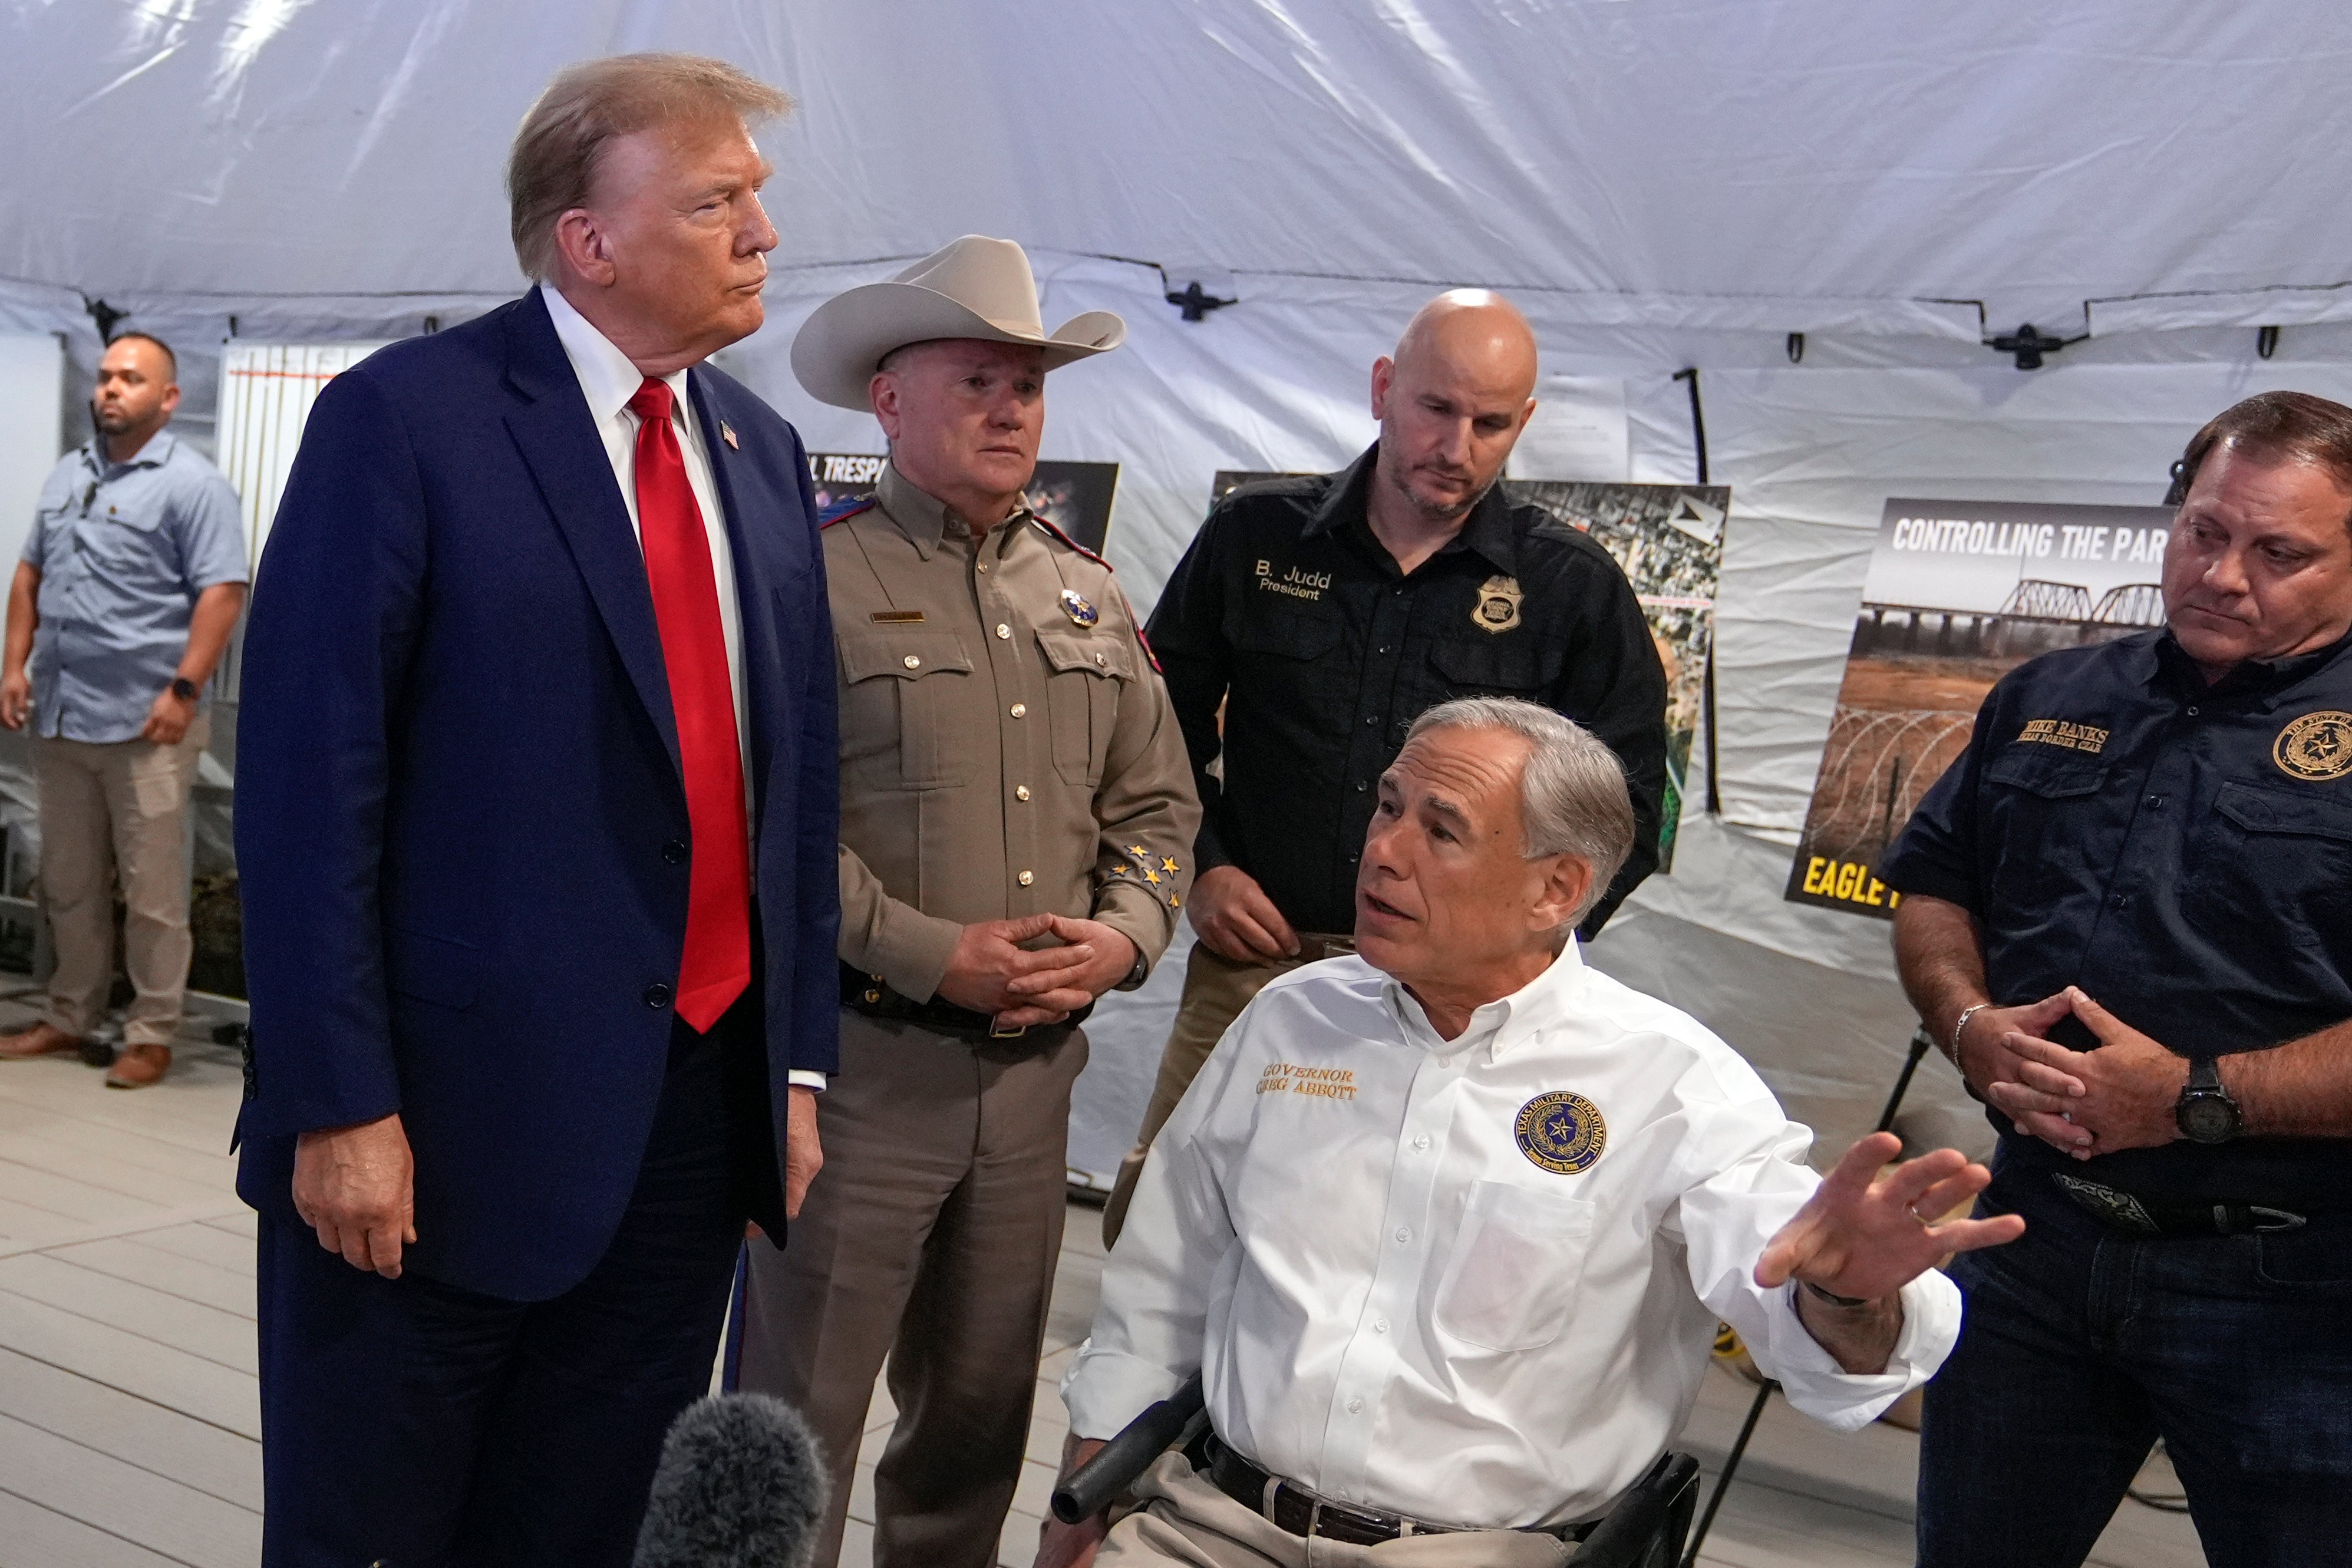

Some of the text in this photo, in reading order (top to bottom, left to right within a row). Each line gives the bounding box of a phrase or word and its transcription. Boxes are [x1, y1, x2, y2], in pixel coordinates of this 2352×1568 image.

[1892, 517, 2169, 563] CONTROLLING THE PAR
[1255, 559, 1332, 590] B. Judd
[1259, 577, 1320, 600] President
[2023, 719, 2110, 744] MIKE BANKS
[1802, 856, 1886, 906] EAGLE
[1264, 1064, 1354, 1083] GOVERNOR
[1256, 1077, 1357, 1101] GREG ABBOTT
[1518, 1093, 1603, 1157] TEXAS MILITARY DEPARTMENT
[1542, 1158, 1563, 1171] Serving
[1563, 1162, 1580, 1171] Texas
